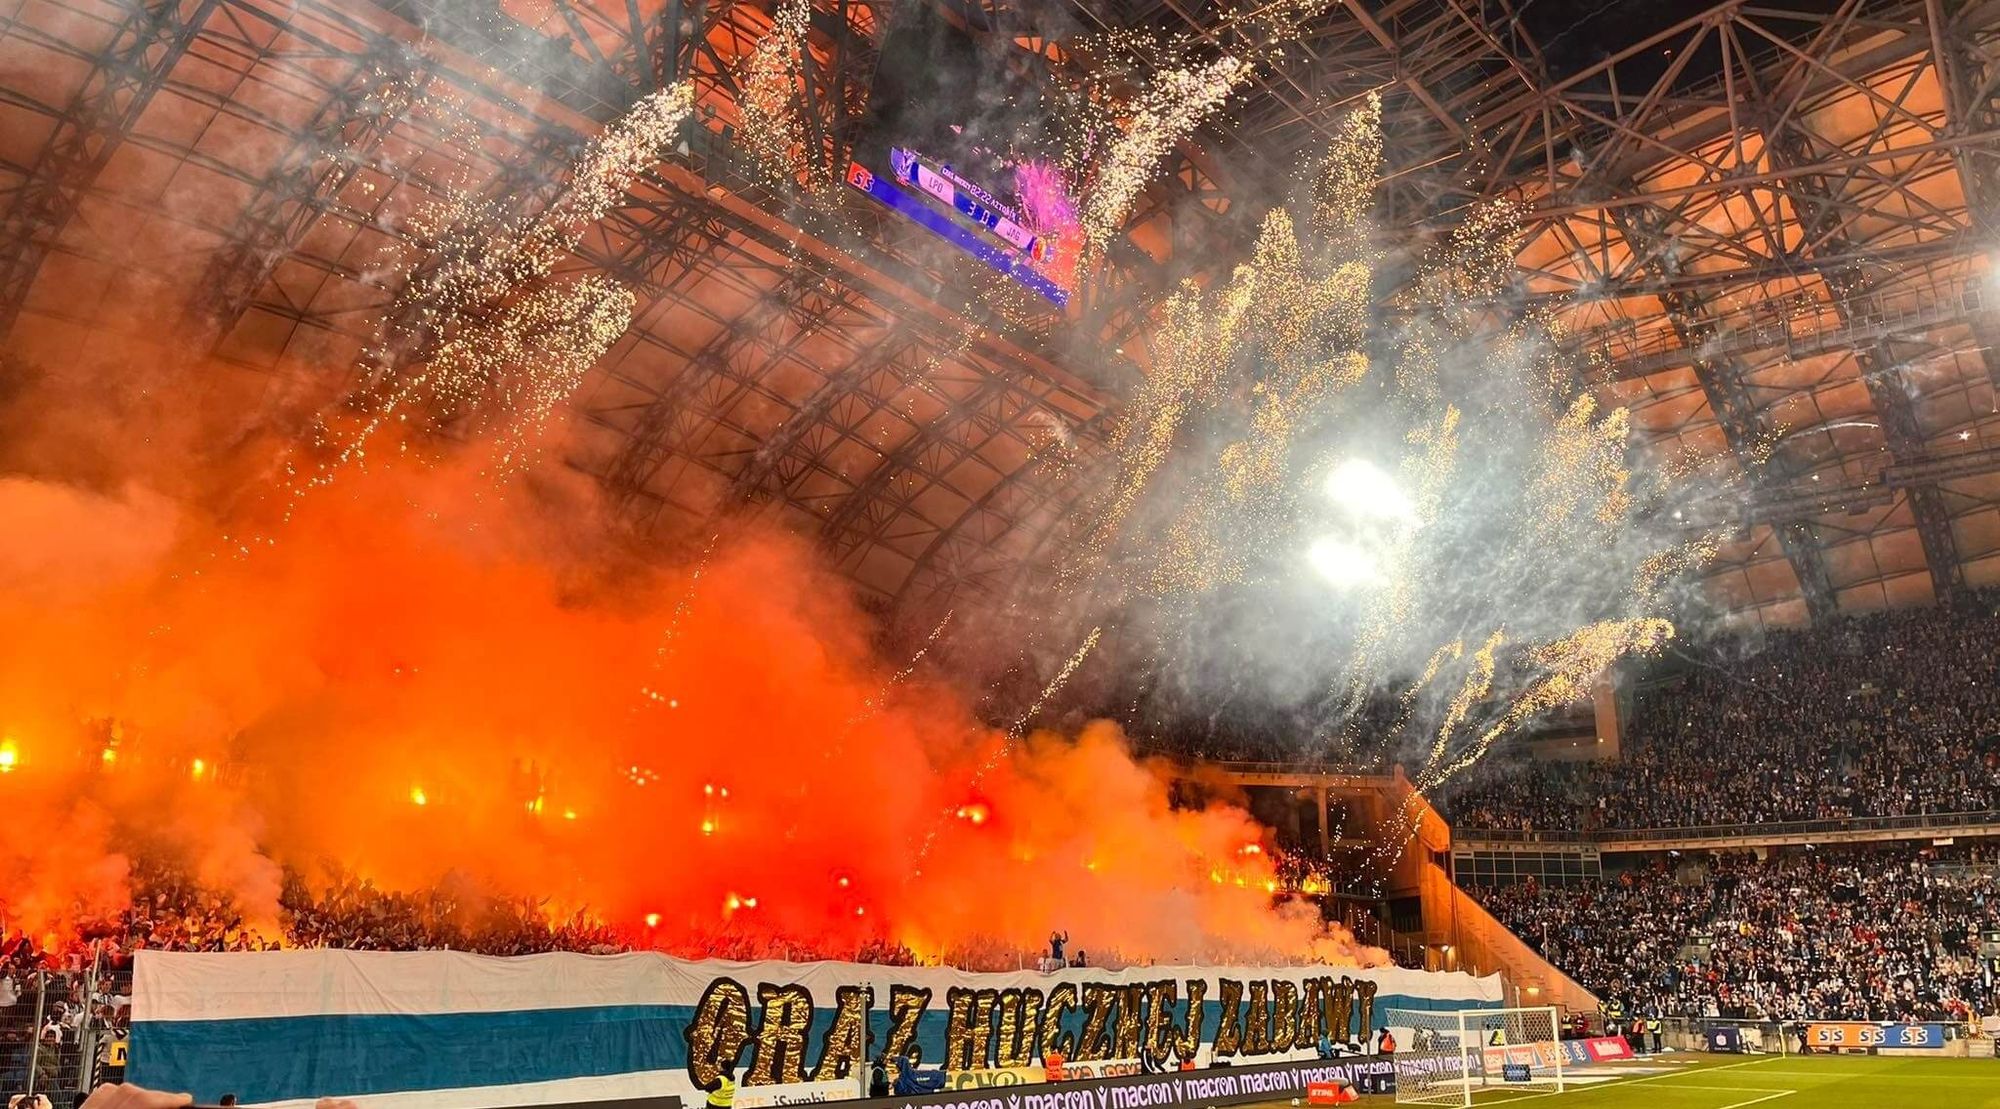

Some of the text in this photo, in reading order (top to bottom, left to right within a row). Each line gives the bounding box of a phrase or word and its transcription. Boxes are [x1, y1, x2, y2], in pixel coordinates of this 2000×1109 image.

[967, 201, 977, 216] 3
[684, 976, 1378, 1091] ORAZ HUCZNEJ ZABAWY
[1819, 1028, 1843, 1042] STS
[1860, 1028, 1885, 1043] STS
[1901, 1027, 1928, 1044] STS
[1025, 1090, 1095, 1109] macron
[1111, 1082, 1173, 1109] macron
[1185, 1076, 1238, 1100] macron
[1240, 1071, 1291, 1094] macron
[1301, 1065, 1345, 1087] macron
